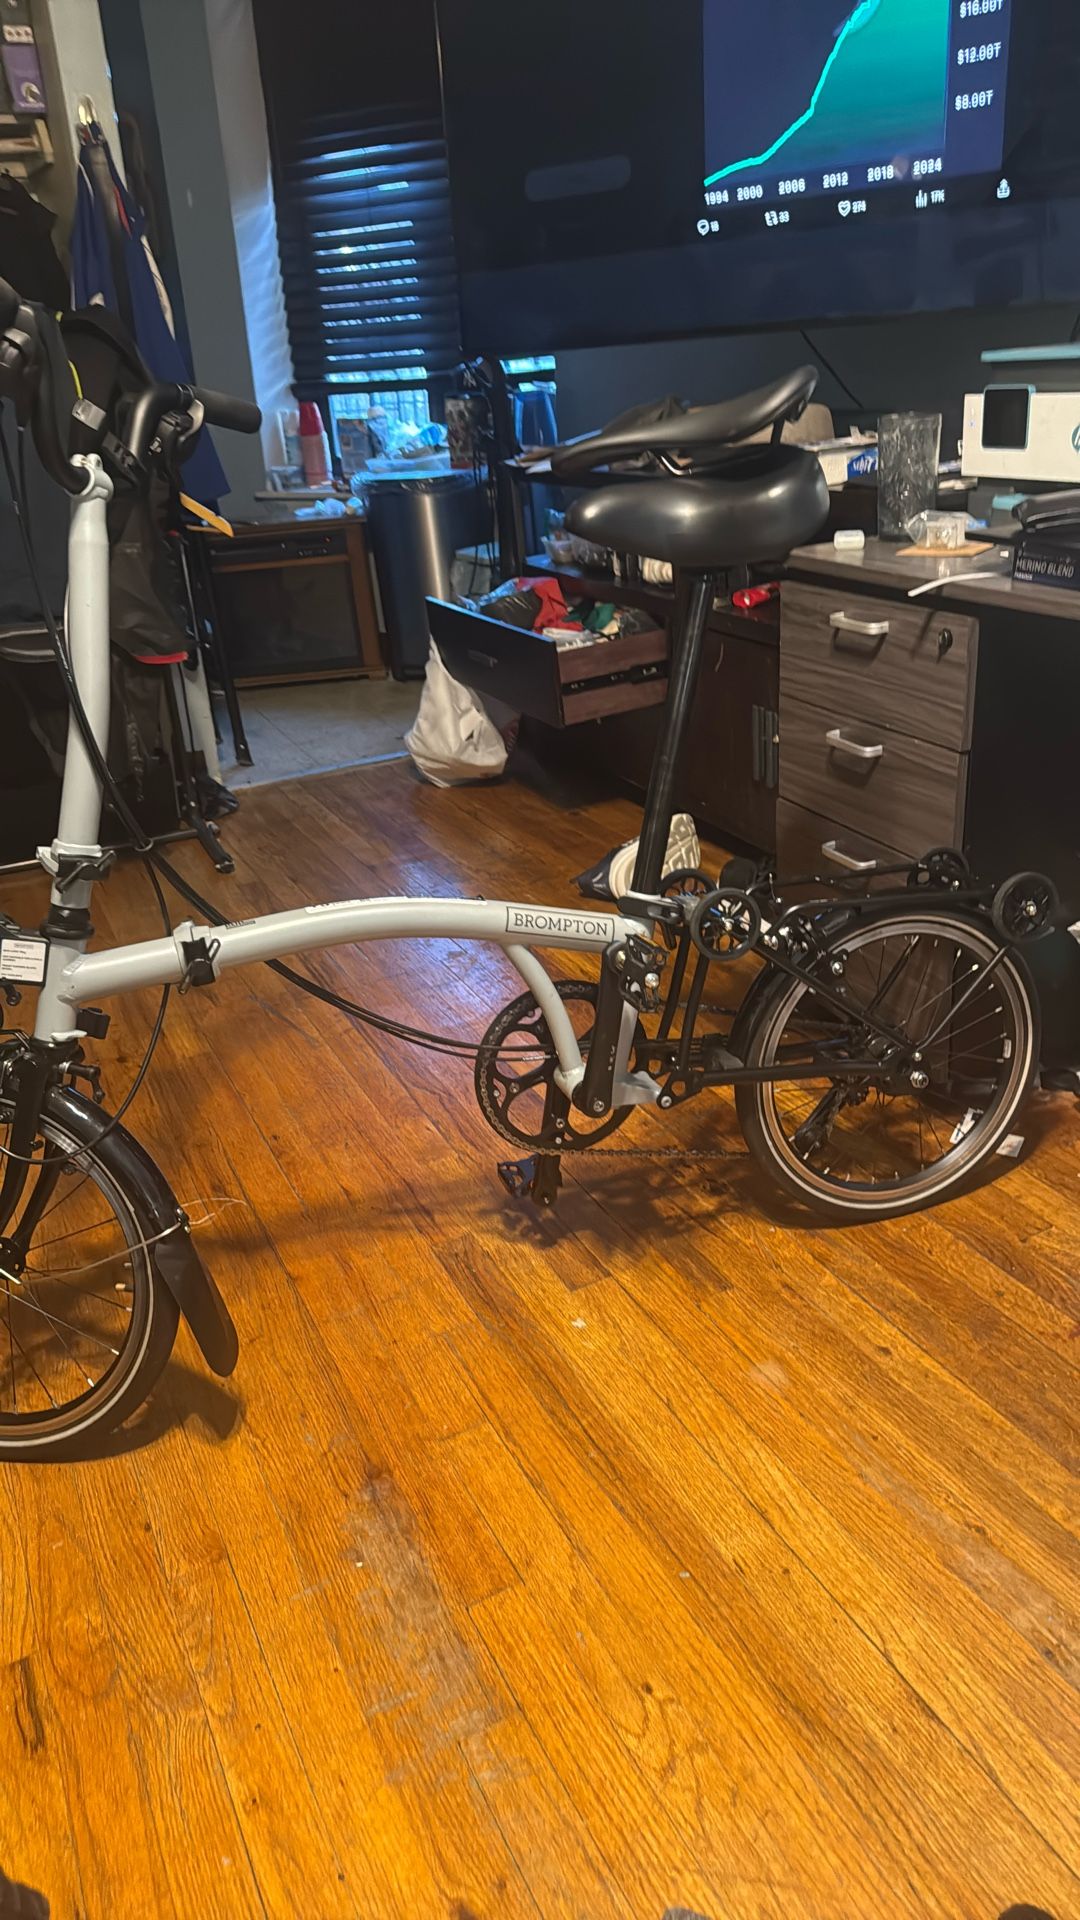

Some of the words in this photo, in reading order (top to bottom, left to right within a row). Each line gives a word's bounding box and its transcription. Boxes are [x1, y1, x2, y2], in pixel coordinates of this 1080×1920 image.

[957, 42, 1002, 65] $12.00T
[955, 90, 994, 111] $8.00T
[704, 190, 729, 206] 1994
[736, 184, 763, 201] 2000
[778, 178, 806, 195] 2006
[822, 171, 849, 189] 2012
[867, 164, 894, 182] 2018
[912, 157, 942, 175] 2024
[1016, 558, 1047, 574] MERINO
[1047, 562, 1074, 578] BLEND
[514, 912, 608, 936] BROMPTON
